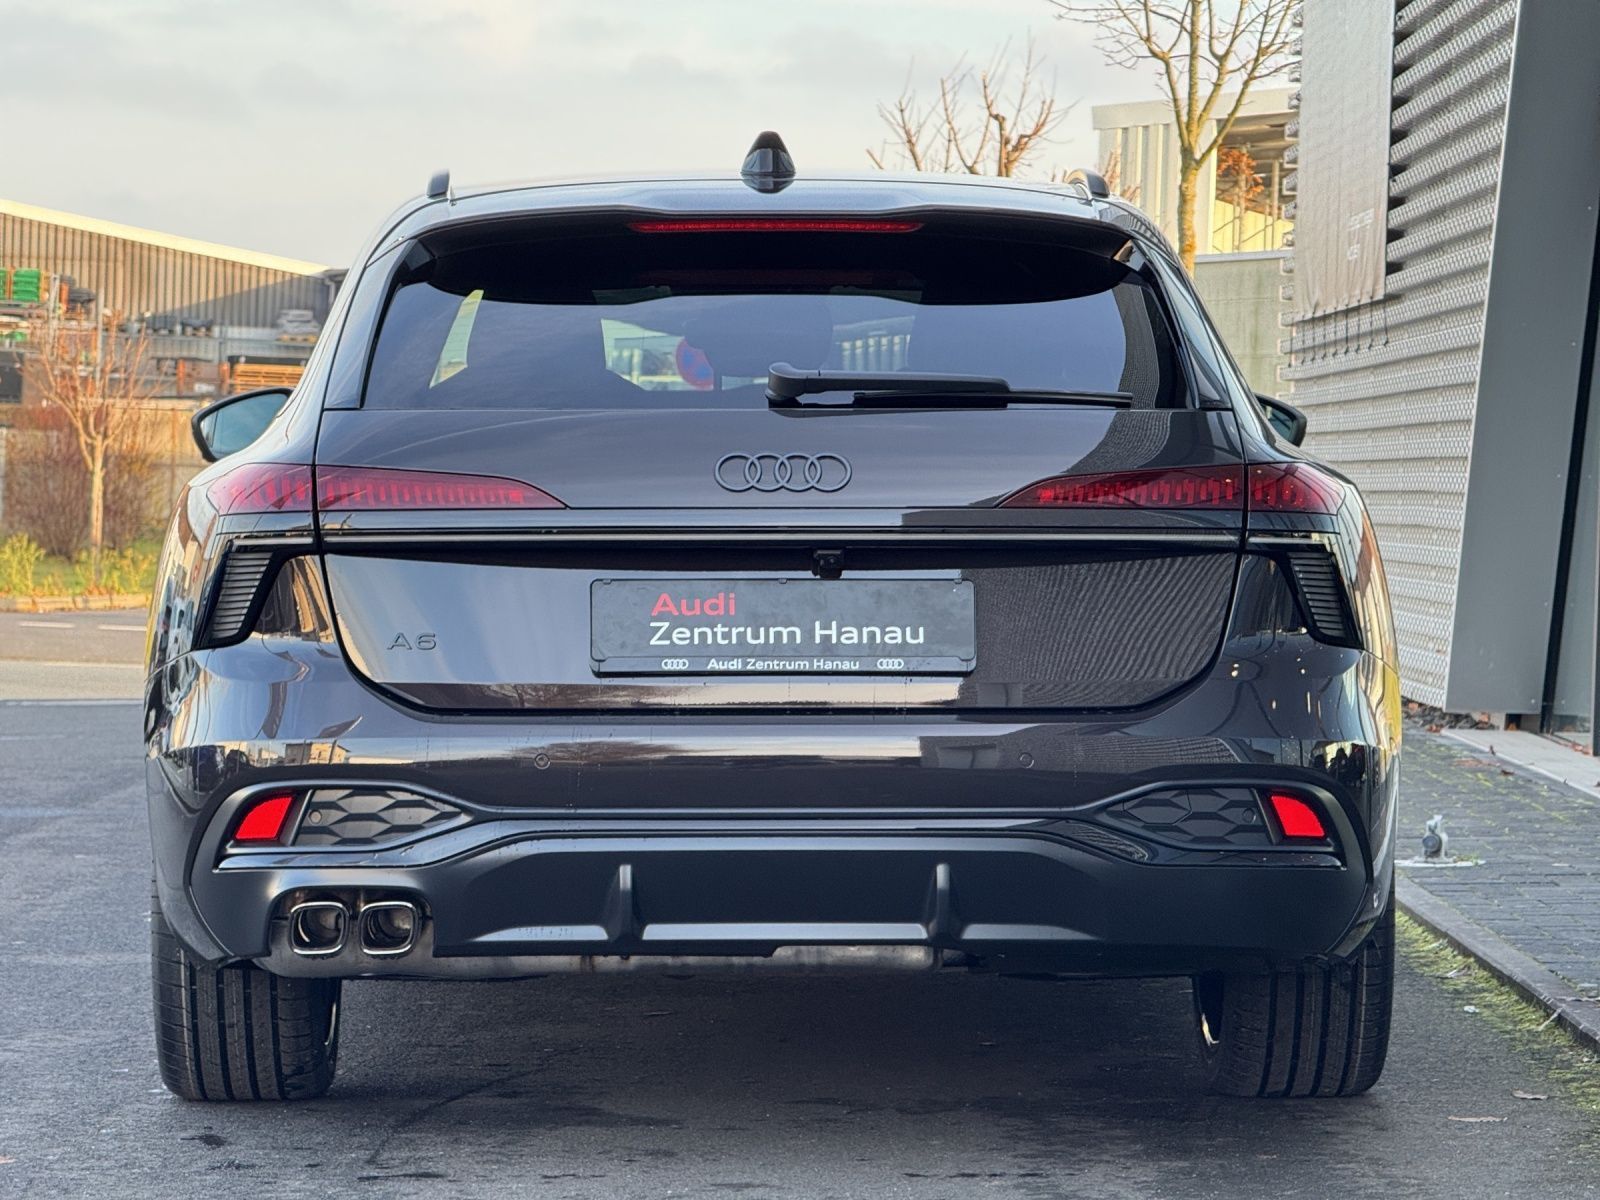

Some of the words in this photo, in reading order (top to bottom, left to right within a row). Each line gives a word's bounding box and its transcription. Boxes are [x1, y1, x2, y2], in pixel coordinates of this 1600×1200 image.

[651, 592, 736, 616] Audi
[387, 632, 437, 651] A6
[649, 621, 802, 646] Zentrum
[815, 620, 925, 646] Hanau
[707, 658, 742, 670] Audi
[745, 658, 805, 670] Zentrum
[813, 658, 860, 670] Hanau
